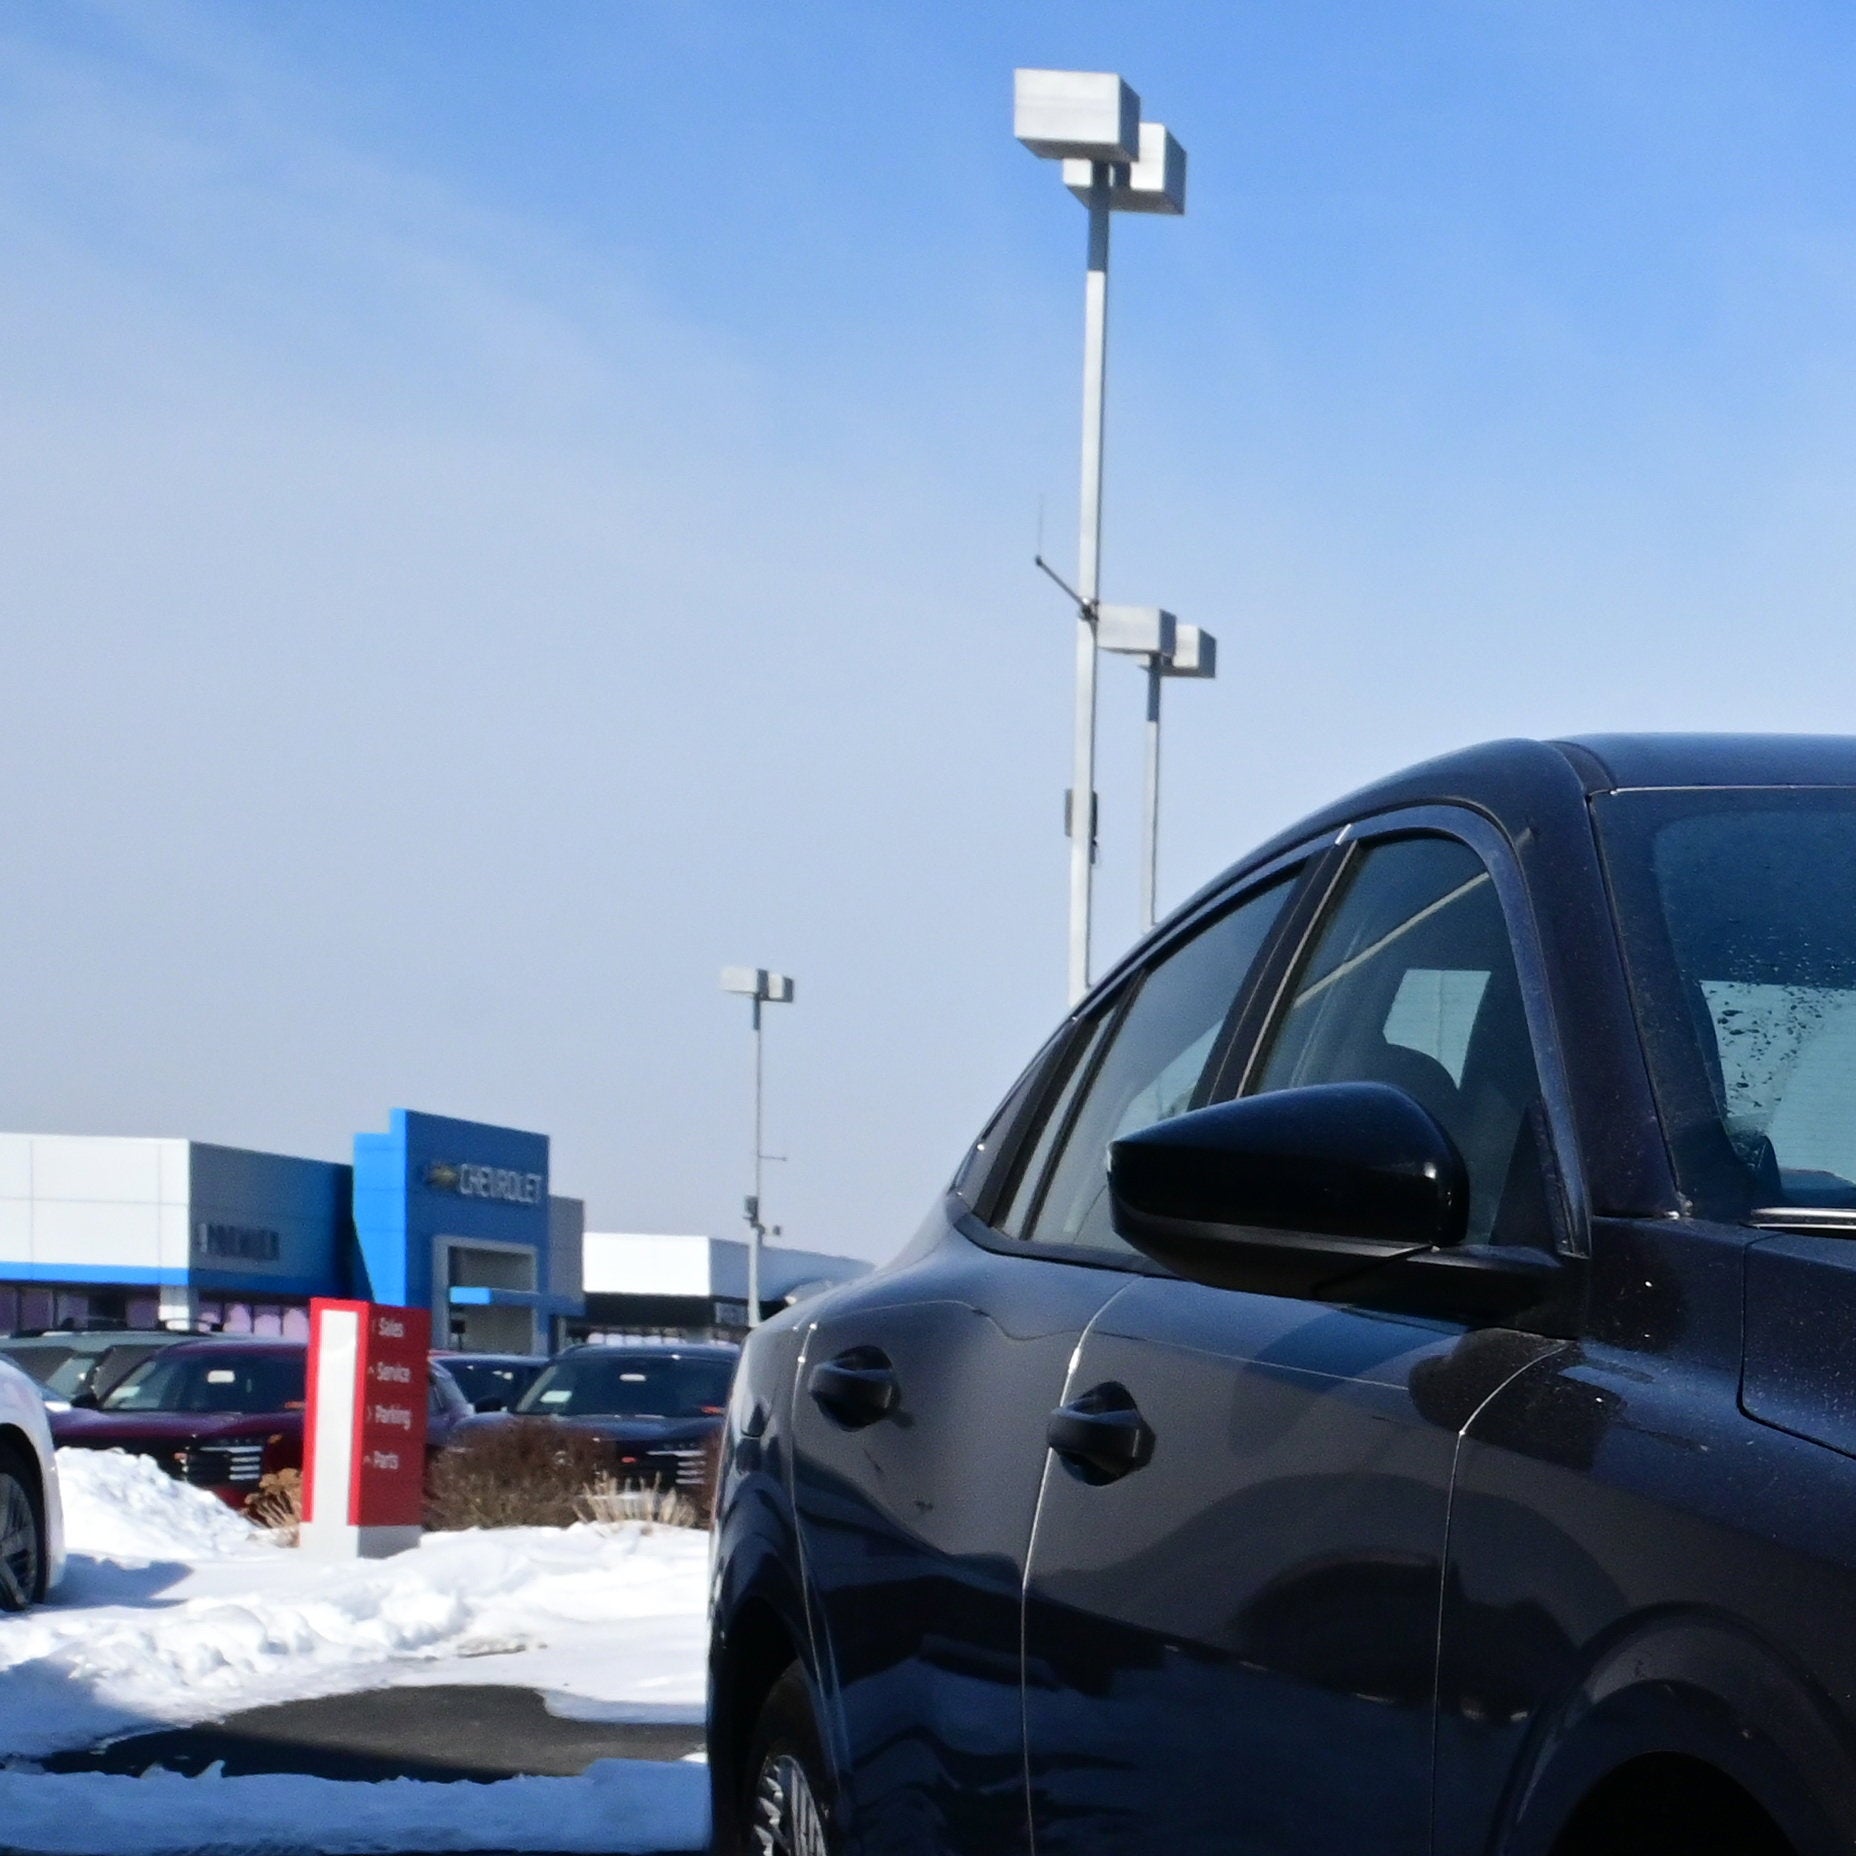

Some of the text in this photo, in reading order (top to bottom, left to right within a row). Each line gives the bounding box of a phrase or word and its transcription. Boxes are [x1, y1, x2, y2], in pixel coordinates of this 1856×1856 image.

[459, 1163, 543, 1204] CHEVROLET
[378, 1317, 405, 1338] Sales
[376, 1361, 411, 1383] Service
[375, 1404, 412, 1431] Parking
[373, 1450, 399, 1470] Parts
